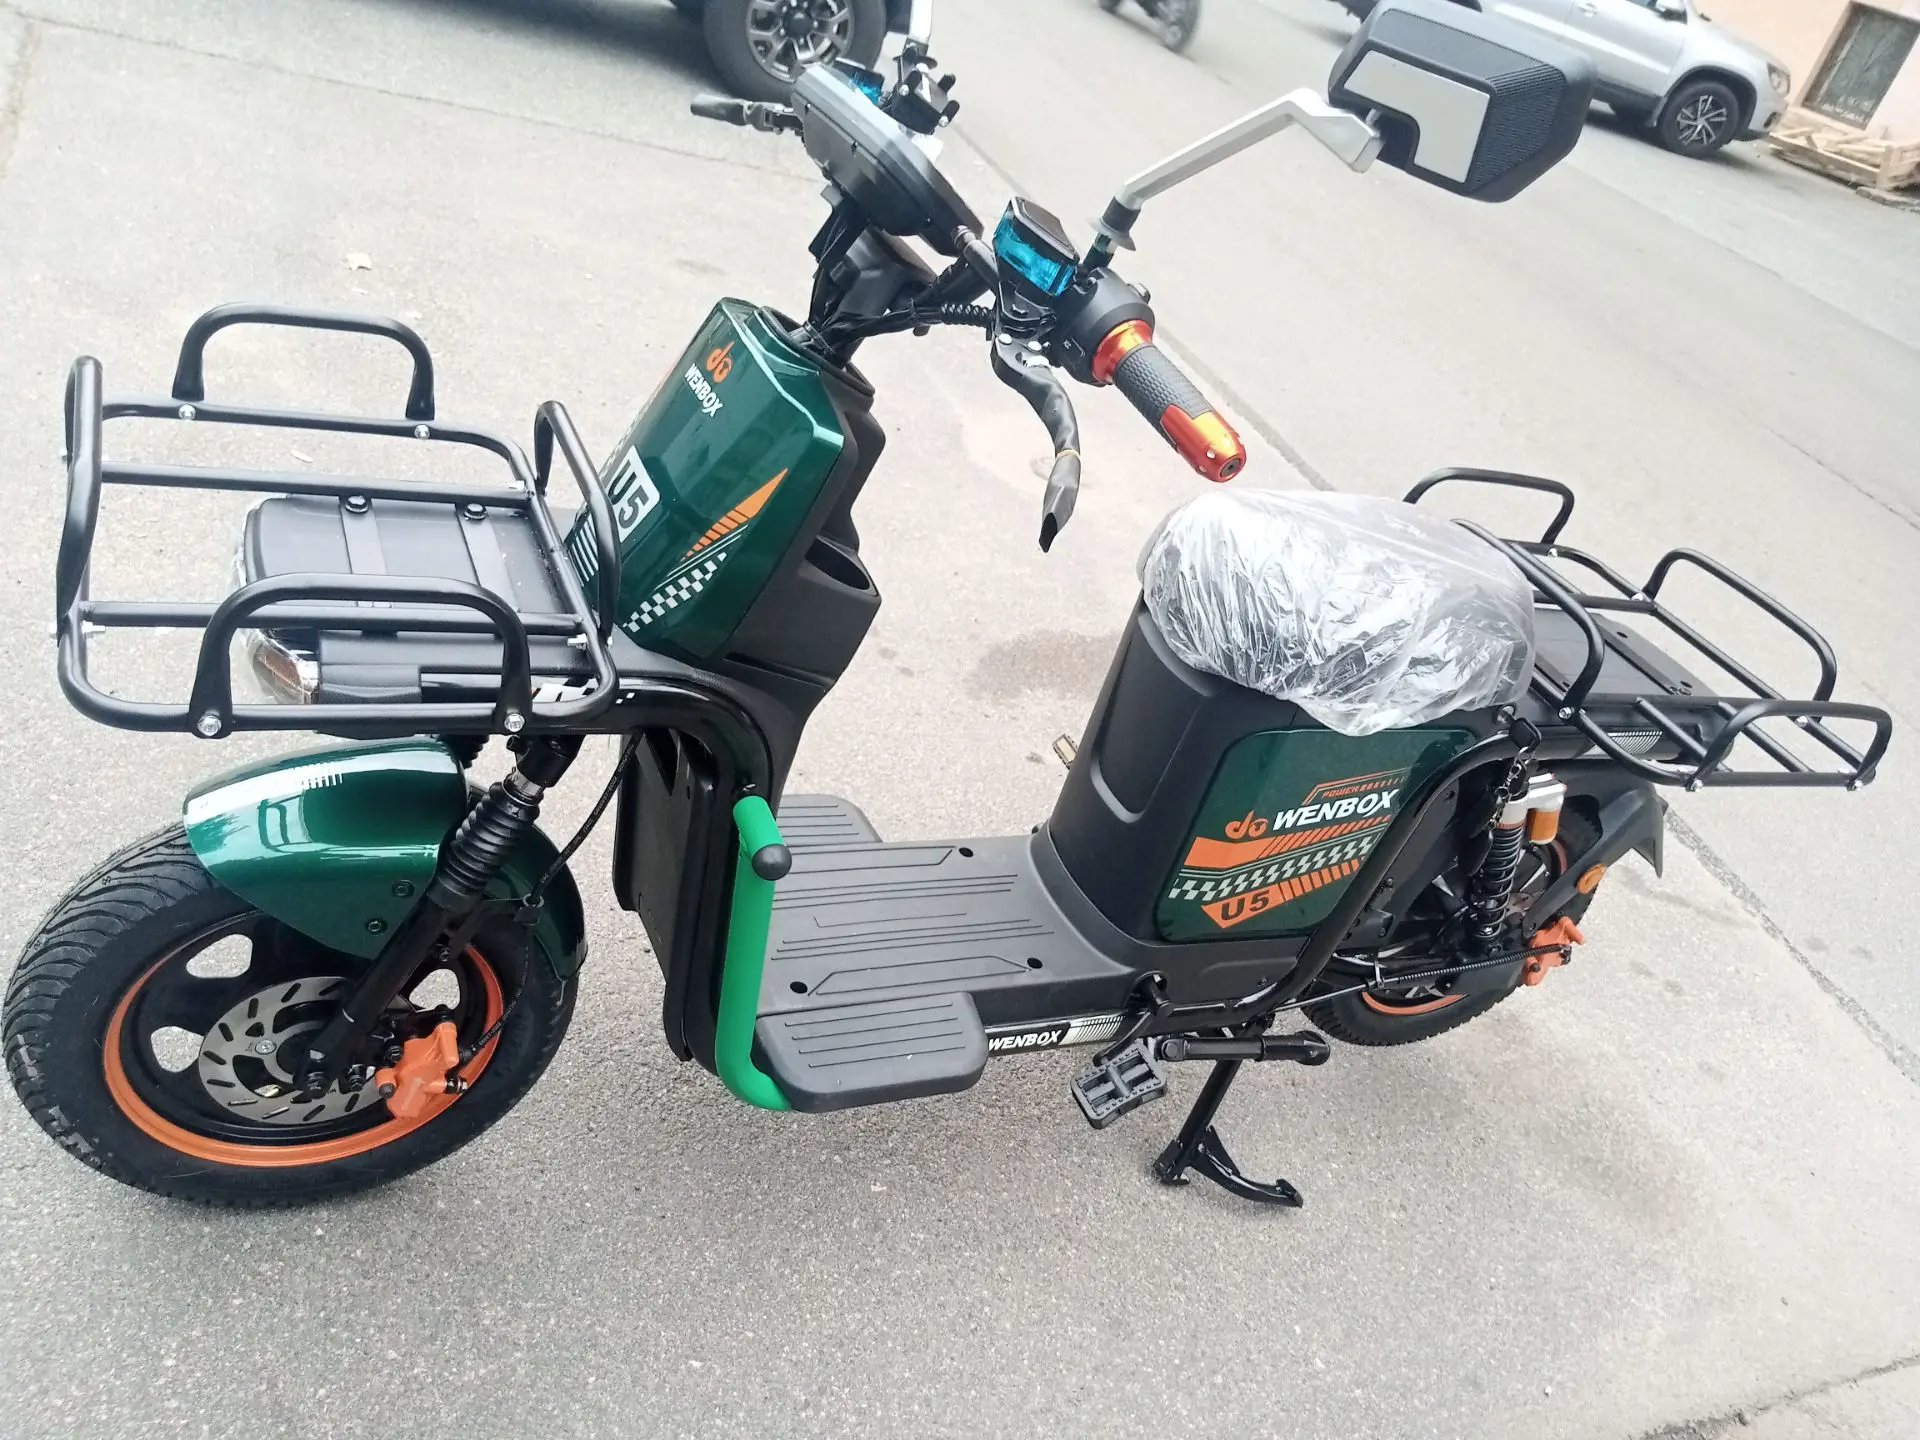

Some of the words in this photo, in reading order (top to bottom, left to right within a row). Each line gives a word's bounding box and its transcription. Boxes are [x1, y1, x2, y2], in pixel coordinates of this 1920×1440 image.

[685, 363, 723, 417] WENBOX
[608, 460, 649, 529] U5
[1273, 789, 1399, 831] WENBOX
[1220, 890, 1270, 921] U5
[988, 1029, 1062, 1051] WENBOX
